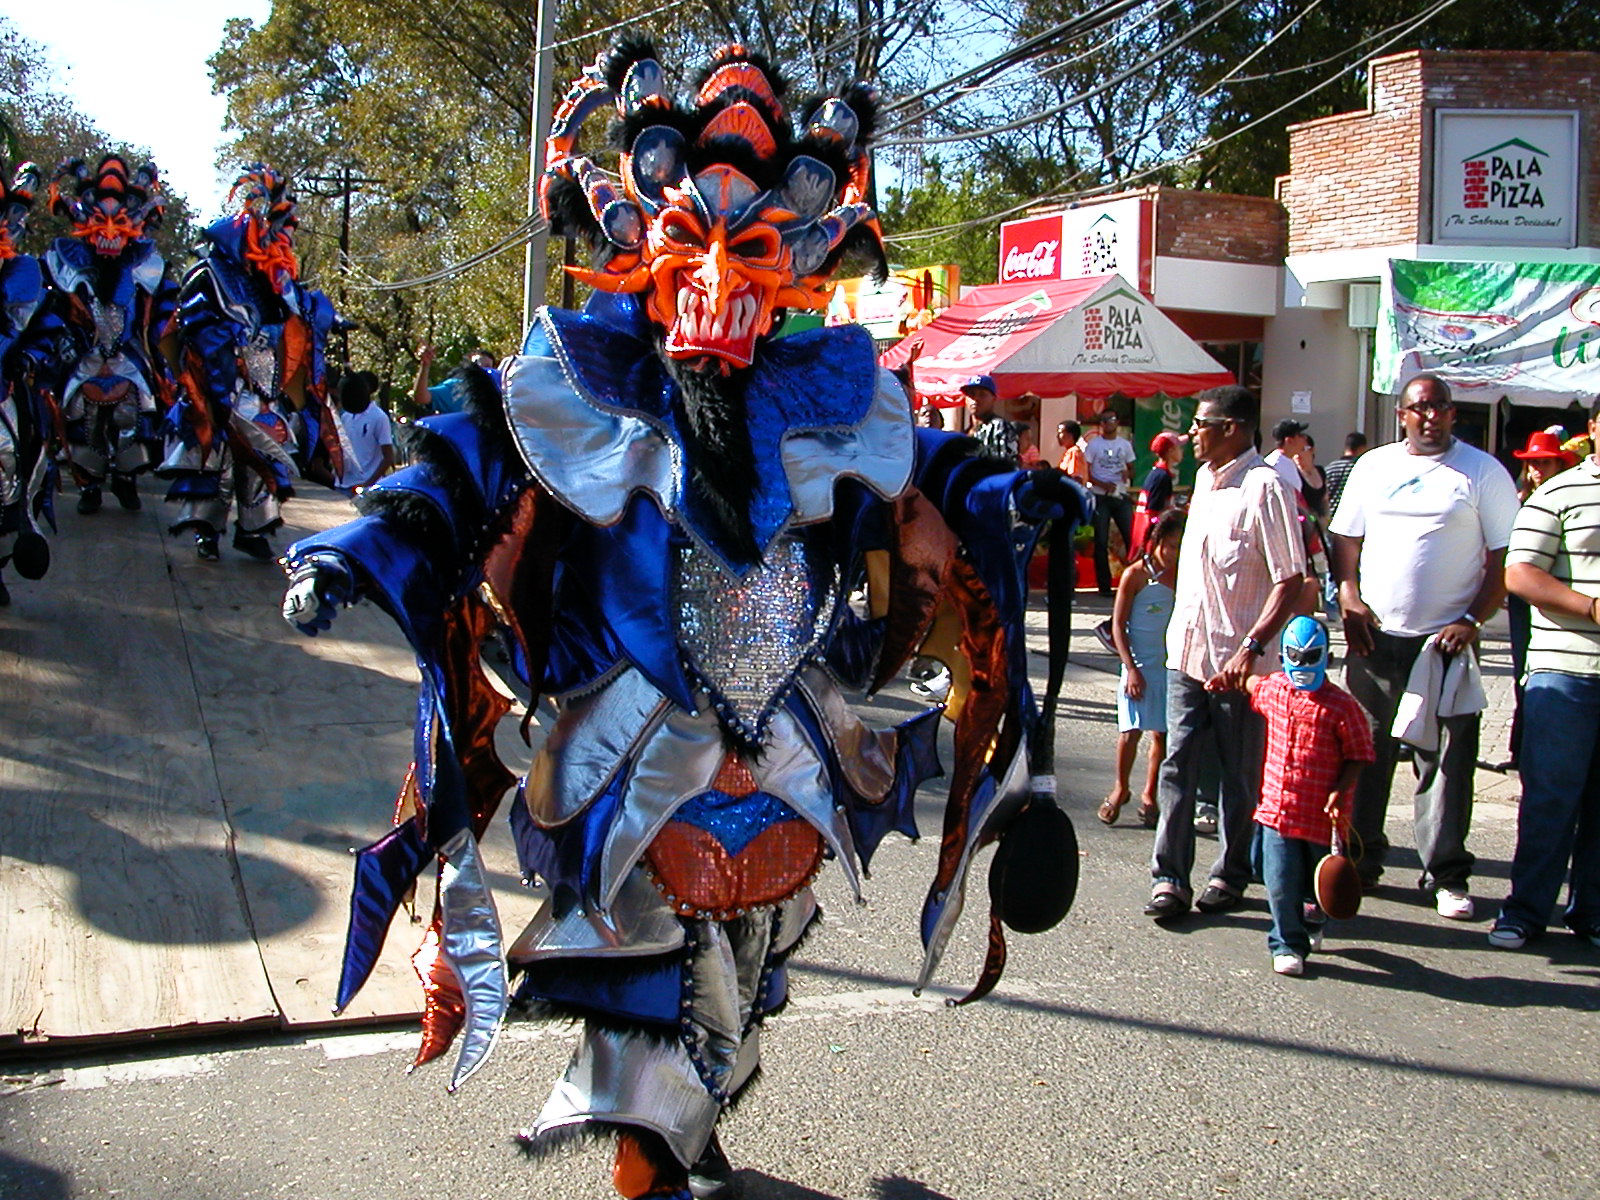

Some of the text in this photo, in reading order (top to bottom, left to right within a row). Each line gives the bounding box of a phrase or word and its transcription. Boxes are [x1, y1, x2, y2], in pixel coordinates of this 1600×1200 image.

[1491, 156, 1542, 181] PALA
[1468, 214, 1510, 226] Sabrosa
[1093, 245, 1118, 273] PZZA
[1108, 305, 1142, 328] PALA
